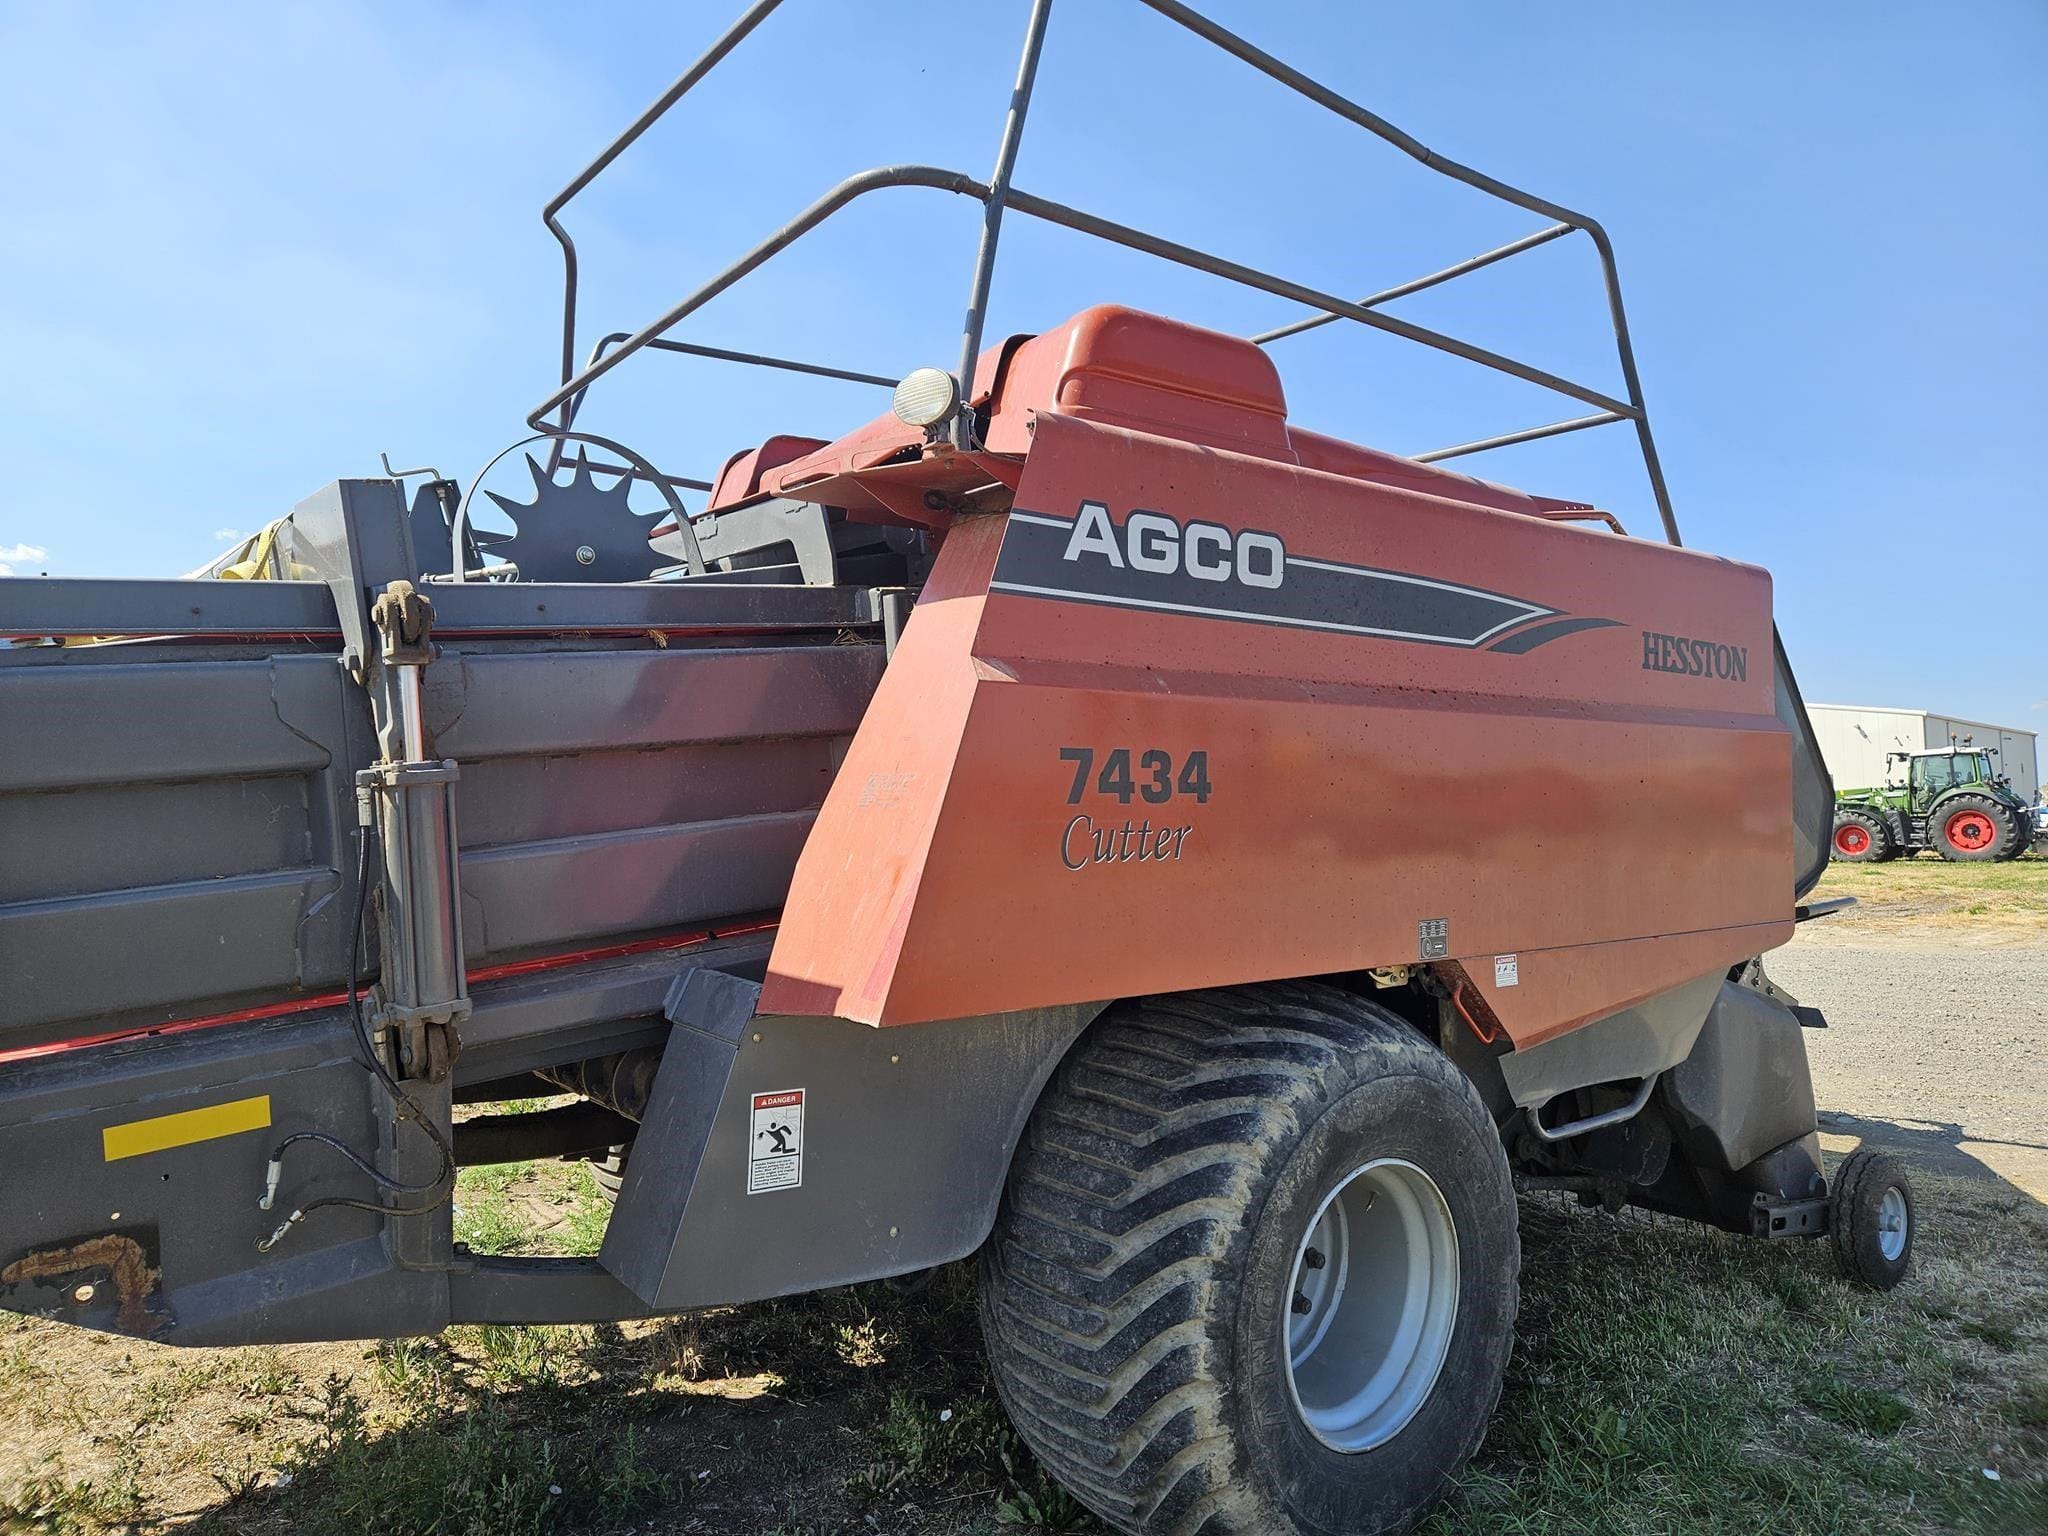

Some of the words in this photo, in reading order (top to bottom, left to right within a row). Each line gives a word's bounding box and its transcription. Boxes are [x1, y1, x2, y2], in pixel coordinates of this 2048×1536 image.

[1062, 503, 1285, 590] AGCO
[1641, 631, 1748, 682] HESSTON
[1059, 747, 1212, 805] 7434
[1060, 814, 1193, 871] Cutter
[767, 1095, 796, 1105] DANGER
